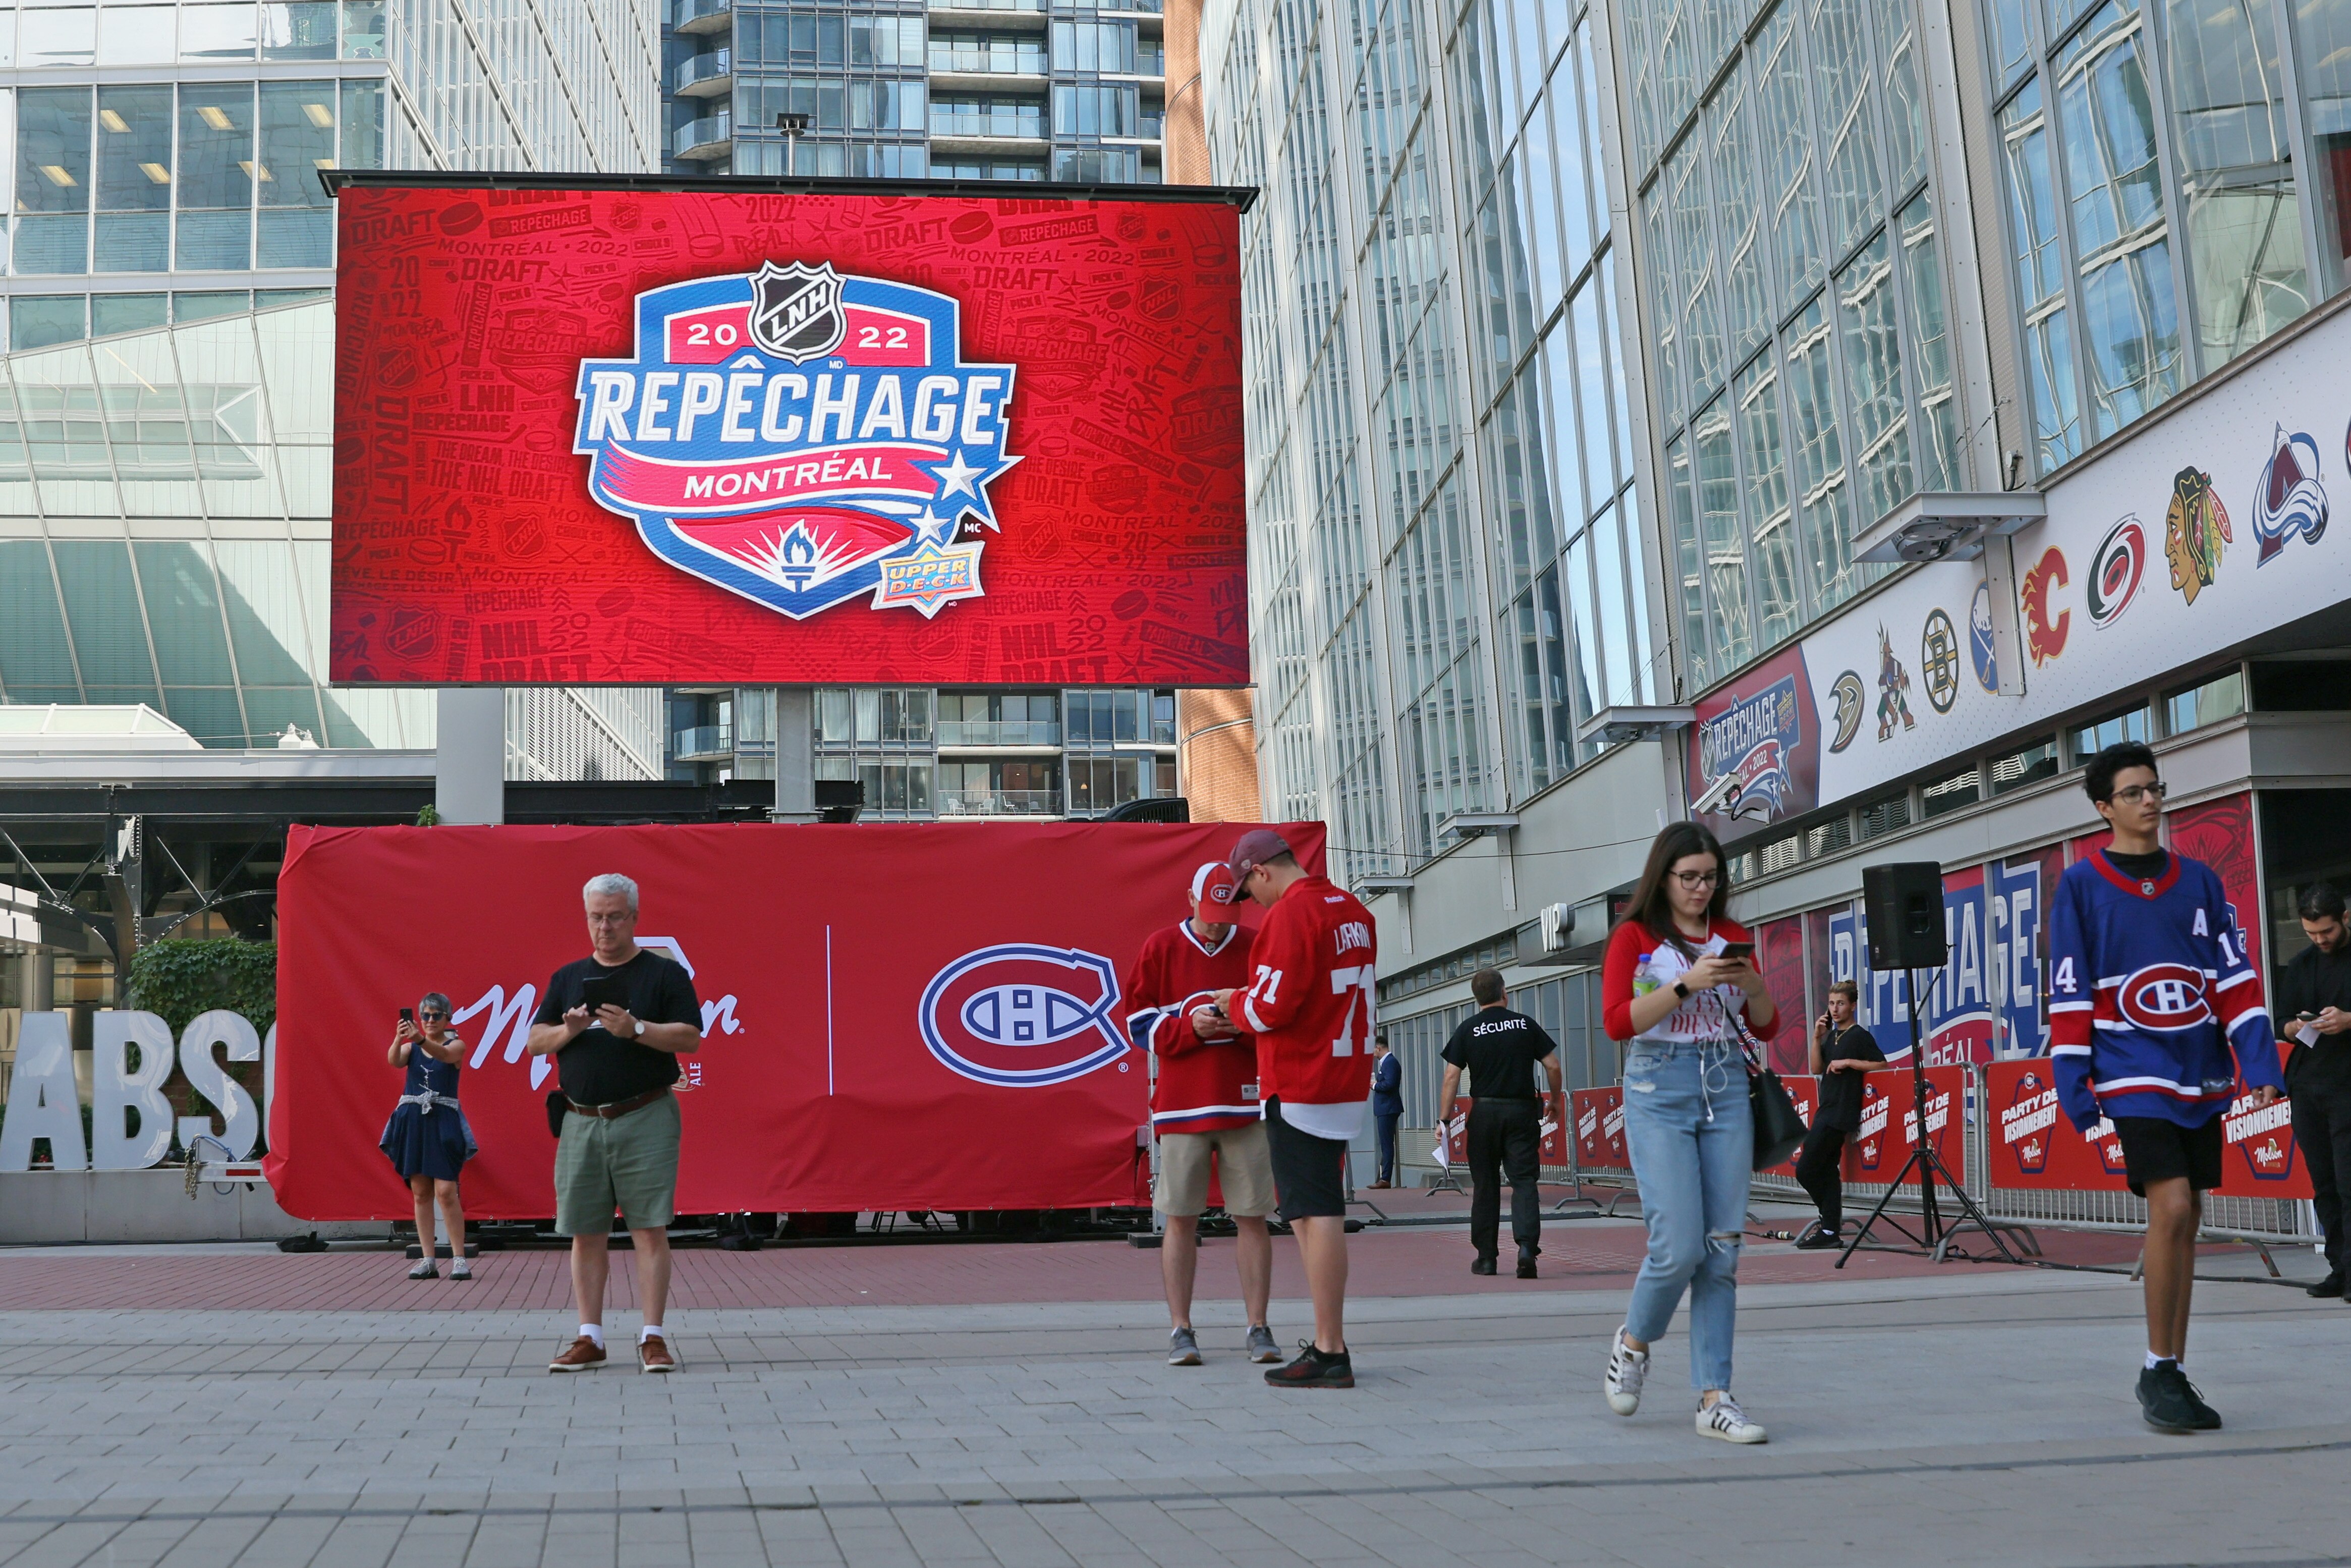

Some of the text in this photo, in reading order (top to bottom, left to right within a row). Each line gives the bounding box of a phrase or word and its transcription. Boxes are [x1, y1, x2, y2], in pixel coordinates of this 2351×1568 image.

[510, 208, 587, 234] REPÊCHAGE
[745, 195, 796, 223] 2022
[352, 209, 436, 245] DRAFT
[863, 217, 947, 253] DRAFT
[1020, 218, 1094, 243] REPÊCHAGE
[438, 238, 628, 257] MONTRÉAL 2022
[949, 246, 1134, 266] MONTRÉAL 2022
[390, 255, 420, 288] 20
[461, 258, 550, 283] DRAFT
[973, 266, 1058, 290] DRAFT
[391, 289, 423, 317] 22
[771, 283, 826, 335] LNH
[1145, 288, 1175, 312] NHL
[687, 323, 909, 350] 20 22
[1002, 335, 1107, 363] REPÊCHAGE
[829, 360, 844, 370] MD
[460, 384, 515, 411] LNH
[587, 355, 1001, 443] REPÊCHAGE
[375, 396, 409, 515] DRAFT
[437, 439, 458, 459] THE
[508, 449, 530, 469] THE
[430, 459, 465, 490] THE
[467, 464, 503, 495] NHL
[508, 470, 569, 503] DRAFT
[683, 453, 892, 499] MONTRÉAL
[1023, 474, 1083, 508] DRAFT
[337, 517, 439, 540] REPÊCHAGE
[511, 518, 538, 548] LNH
[964, 523, 981, 533] MC
[1123, 531, 1149, 553] 20
[380, 567, 455, 582] LE DÉSIR
[889, 559, 968, 580] UPPER
[1125, 553, 1148, 571] 22
[1127, 573, 1178, 590] 2022
[395, 617, 432, 647] LNH
[548, 612, 591, 634] 20
[1067, 614, 1107, 636] 20
[480, 620, 548, 660] NHL
[547, 632, 591, 653] 22
[999, 622, 1067, 662] NHL
[1066, 634, 1107, 655] 22
[446, 642, 468, 681] HOIX
[480, 654, 592, 681] DRAFT
[1000, 655, 1109, 682] DRAFT
[1713, 692, 1778, 764] REPÊCHAGE
[1752, 749, 1767, 771] 2022
[1540, 903, 1568, 953] VIP
[2193, 908, 2209, 937] A
[1334, 922, 1371, 956] LARKIN
[1834, 887, 2033, 1026] RPHAGE
[1248, 964, 1283, 1004] 71
[1331, 963, 1376, 1057] 71
[1473, 1018, 1528, 1037] SÉCURITÉ
[690, 1062, 701, 1086] ALE
[0, 1010, 277, 1172] ABS
[1460, 1111, 1466, 1122] DE
[1578, 1106, 1596, 1129] PARTY DE
[1603, 1109, 1615, 1126] PARTY
[1798, 1100, 1809, 1114] DE
[1860, 1095, 1889, 1122] RTY DE
[1904, 1091, 1949, 1126] PATY DE
[2002, 1088, 2058, 1125] PARTY DE
[2004, 1103, 2057, 1144] VISIONNEMENT
[2225, 1100, 2291, 1144] VISIONNEME
[2254, 1146, 2283, 1167] Molson
